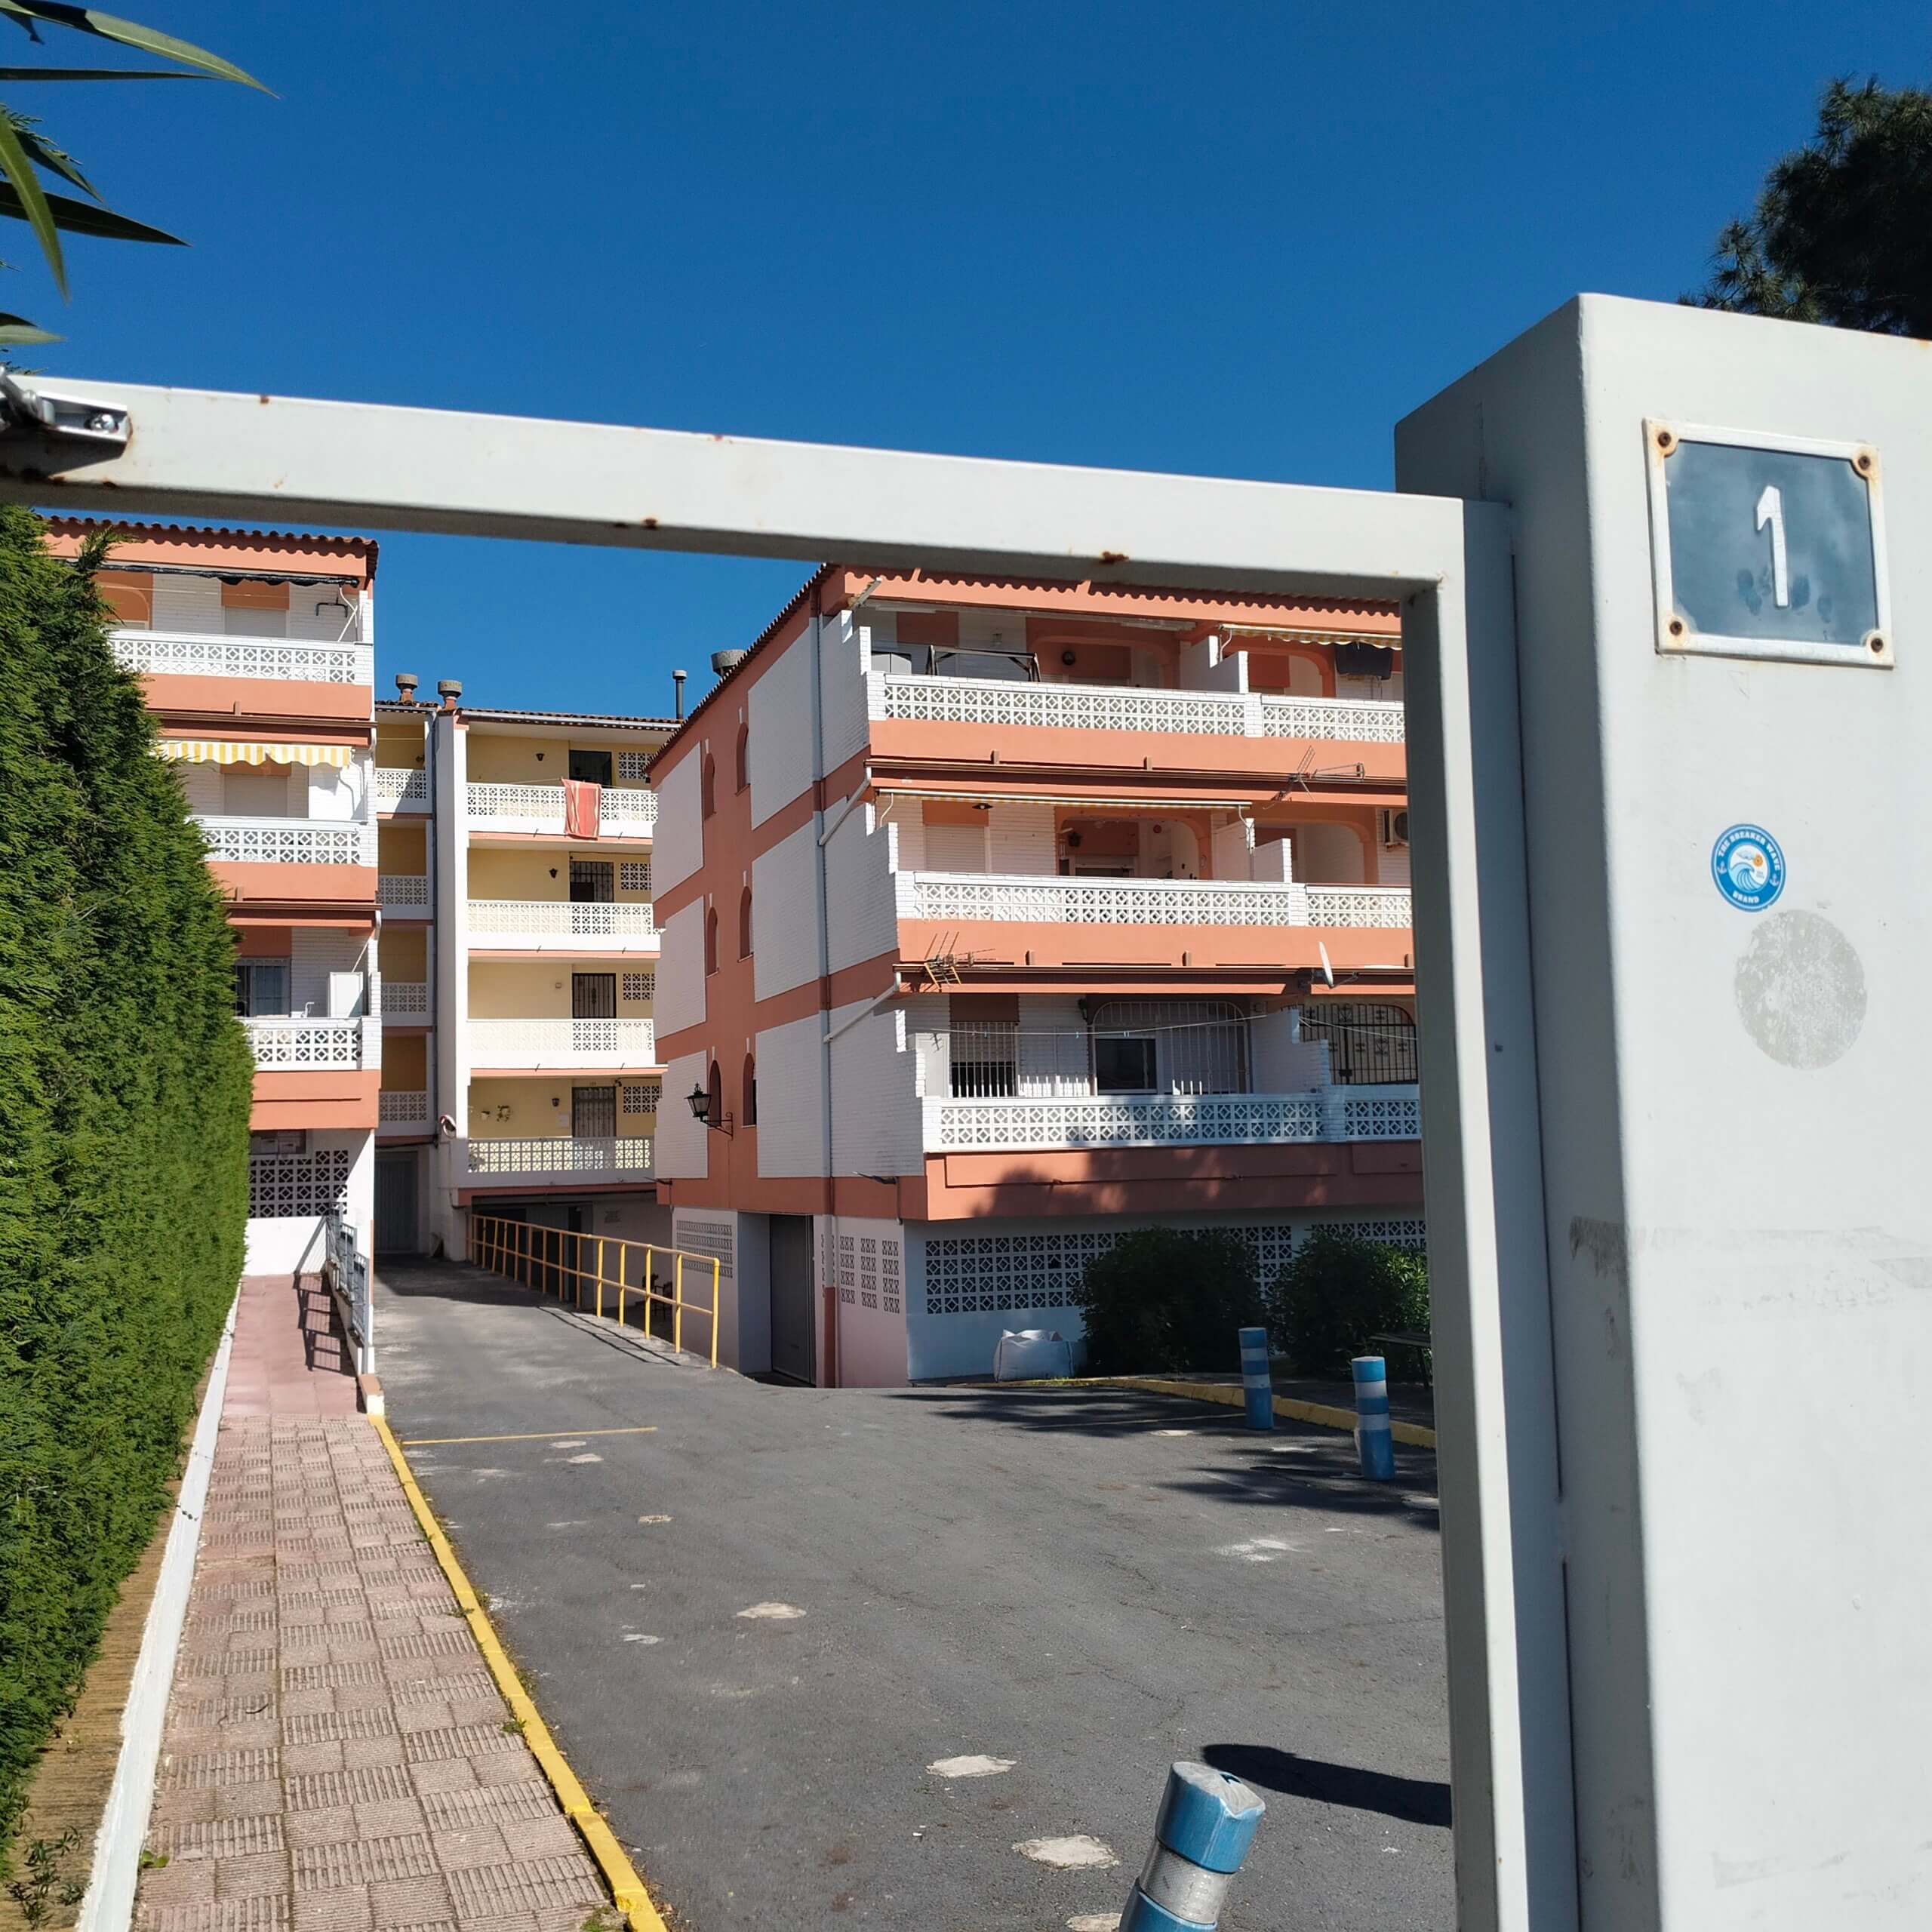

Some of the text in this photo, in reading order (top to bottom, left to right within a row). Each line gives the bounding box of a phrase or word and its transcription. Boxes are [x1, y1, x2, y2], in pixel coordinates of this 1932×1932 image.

[1755, 485, 1789, 608] 1
[1718, 830, 1780, 871] THE BREAKER WAVE
[1733, 891, 1759, 904] BRAND
